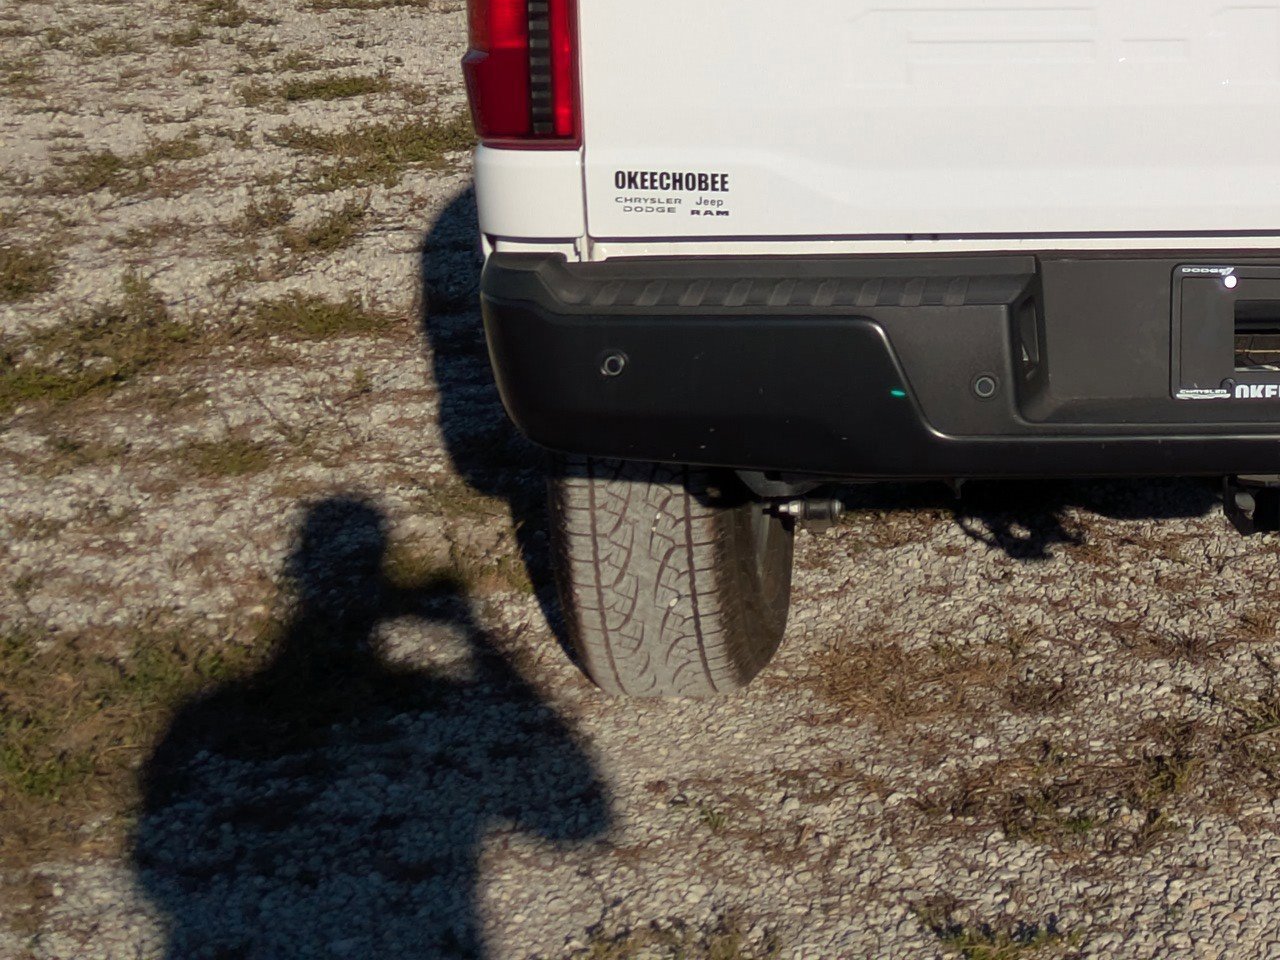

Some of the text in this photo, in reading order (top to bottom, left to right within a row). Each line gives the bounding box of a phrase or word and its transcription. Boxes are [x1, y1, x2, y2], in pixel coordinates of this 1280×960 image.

[614, 170, 729, 192] OKEECHOBEE
[615, 196, 724, 207] CHRYSLER Jeep
